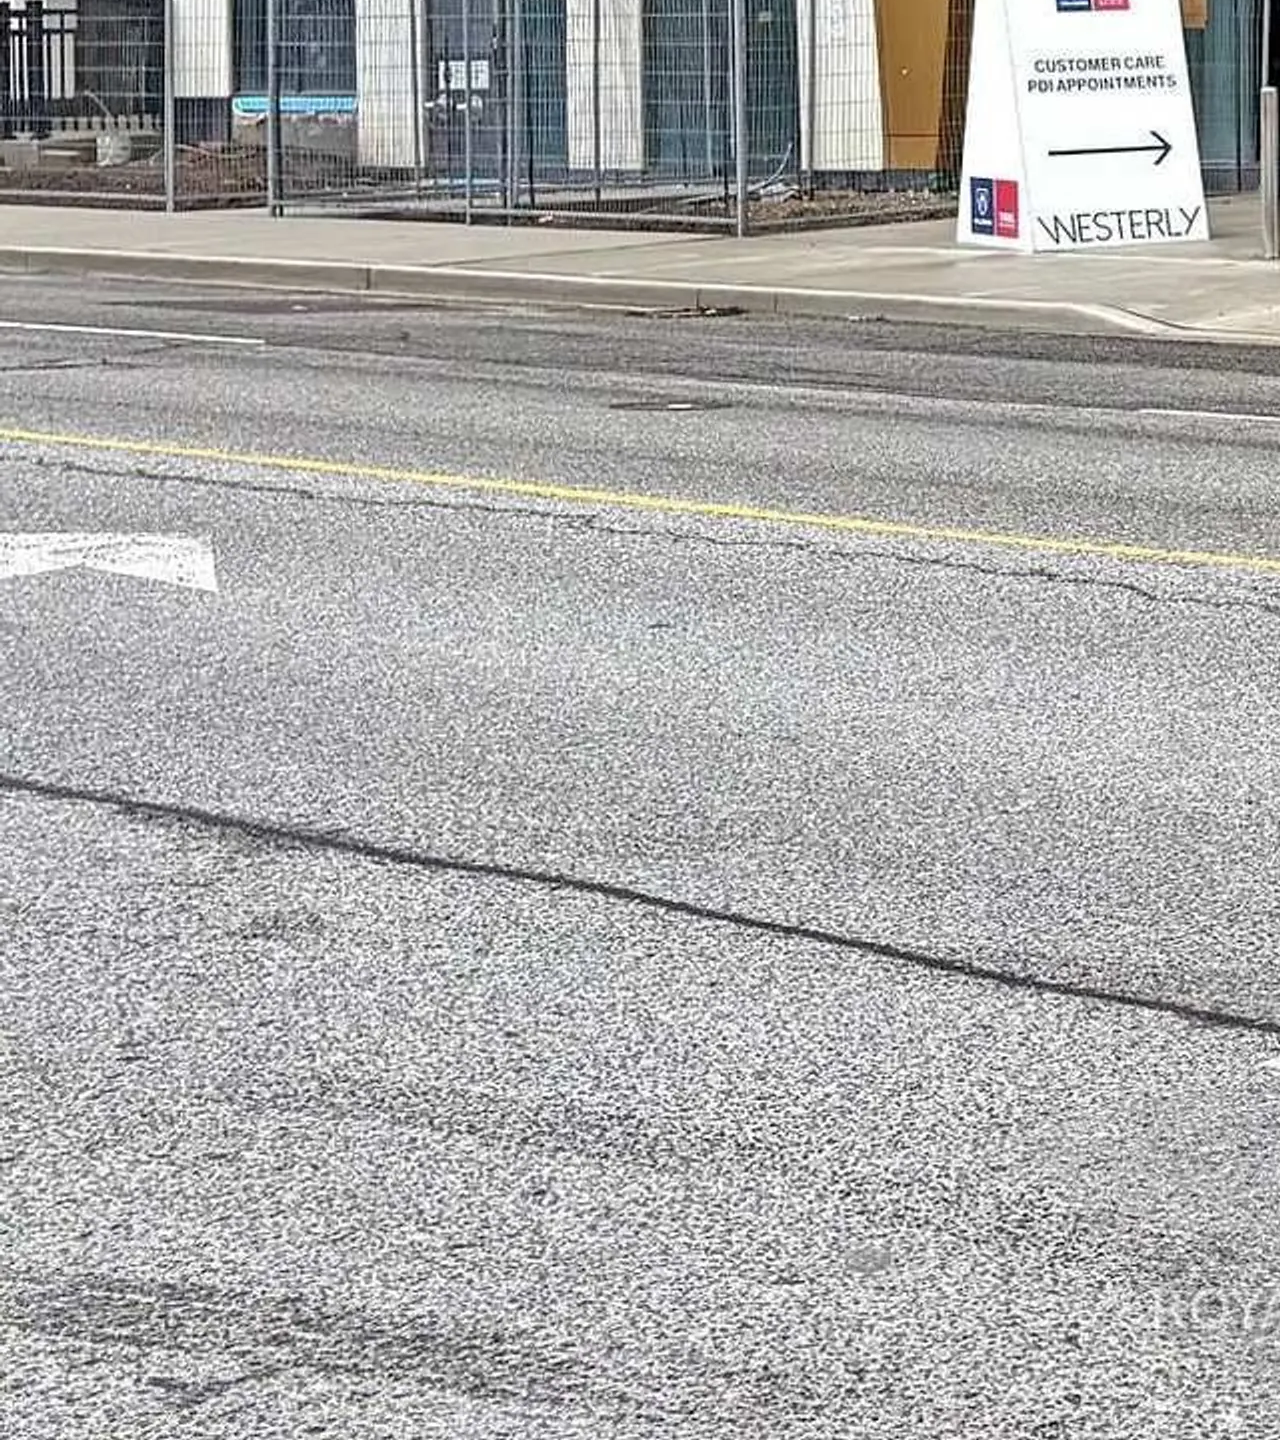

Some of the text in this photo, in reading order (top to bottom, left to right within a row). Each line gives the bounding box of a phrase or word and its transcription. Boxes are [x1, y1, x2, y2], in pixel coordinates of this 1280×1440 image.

[1033, 55, 1165, 73] CUSTOMER CARE
[1056, 75, 1177, 92] APPOINTMENTS
[1037, 206, 1201, 244] WESTERLY
